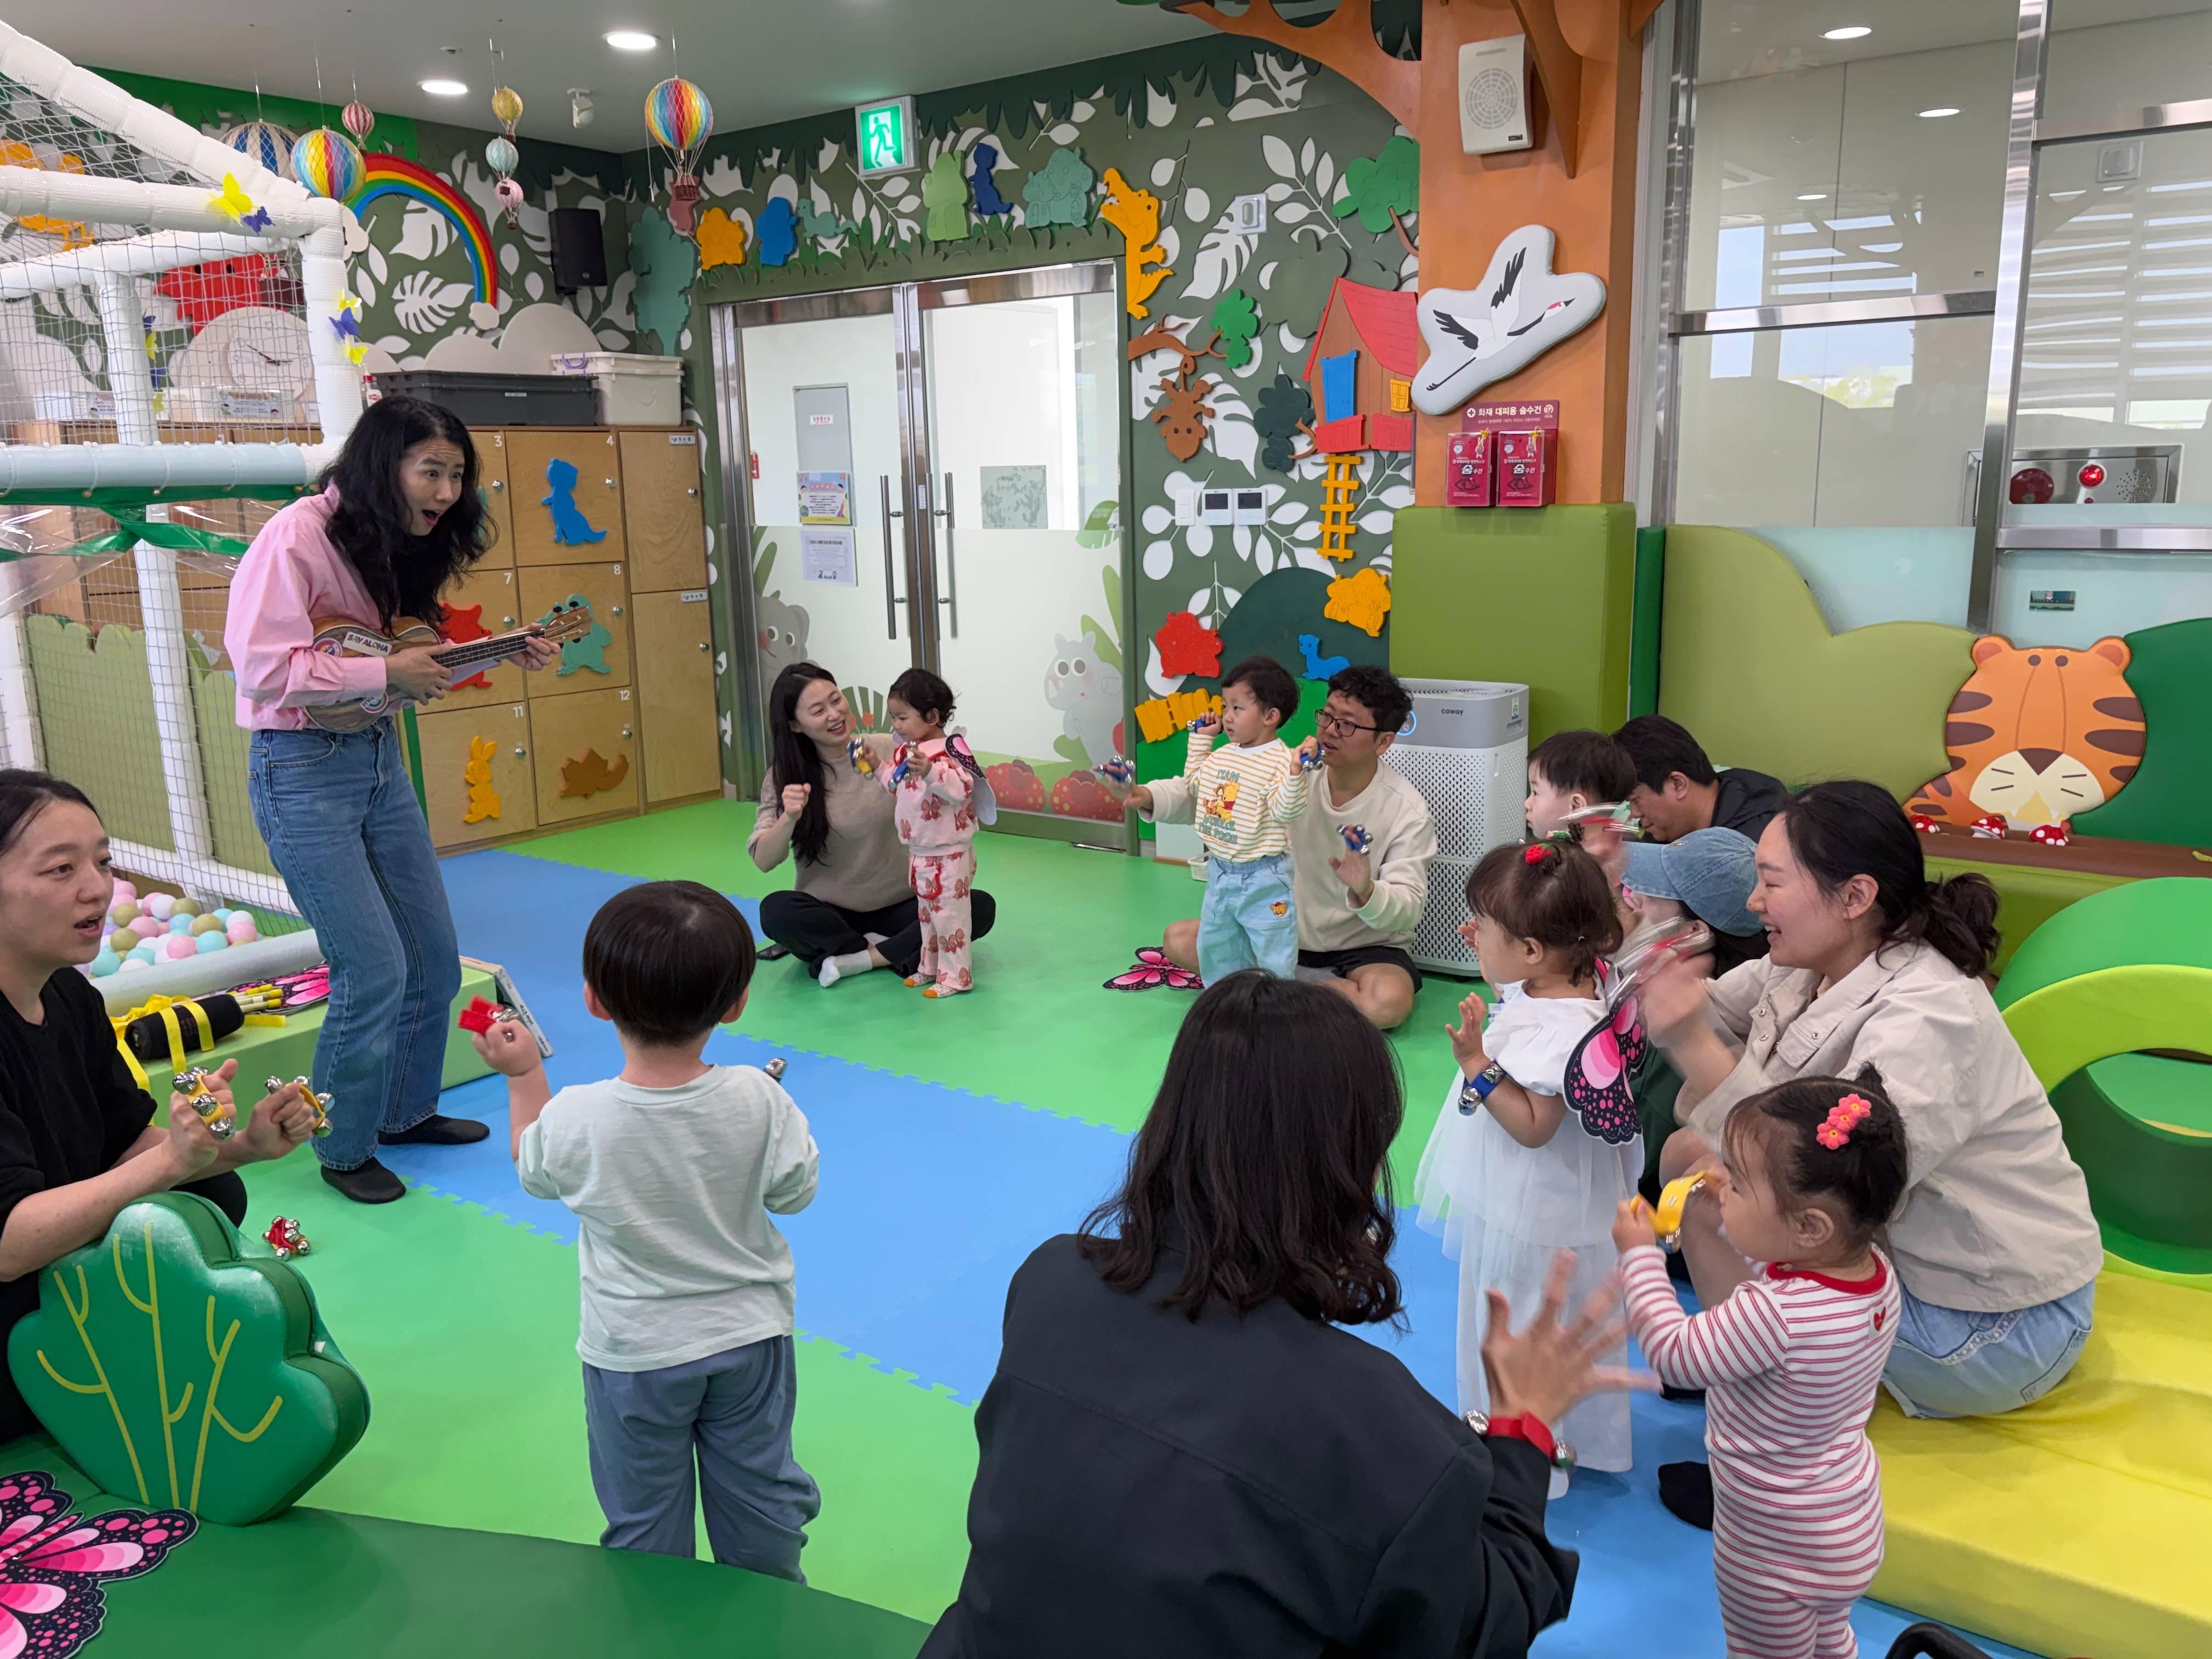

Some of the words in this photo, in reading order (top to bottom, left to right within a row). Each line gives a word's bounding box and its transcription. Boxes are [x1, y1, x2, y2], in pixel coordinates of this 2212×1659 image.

[1478, 408, 1493, 416] 화재
[1495, 407, 1517, 416] 대피용
[1519, 405, 1542, 415] 숨수건
[494, 435, 503, 447] 3
[606, 435, 614, 446] 4
[614, 565, 620, 575] 8
[504, 573, 512, 584] 7
[347, 634, 364, 645] SAY
[363, 639, 388, 652] ALOHA
[619, 690, 630, 701] 12
[513, 706, 523, 718] 11
[1216, 769, 1240, 782] TEAM
[1199, 822, 1212, 836] THE
[1214, 828, 1238, 844] POOH
